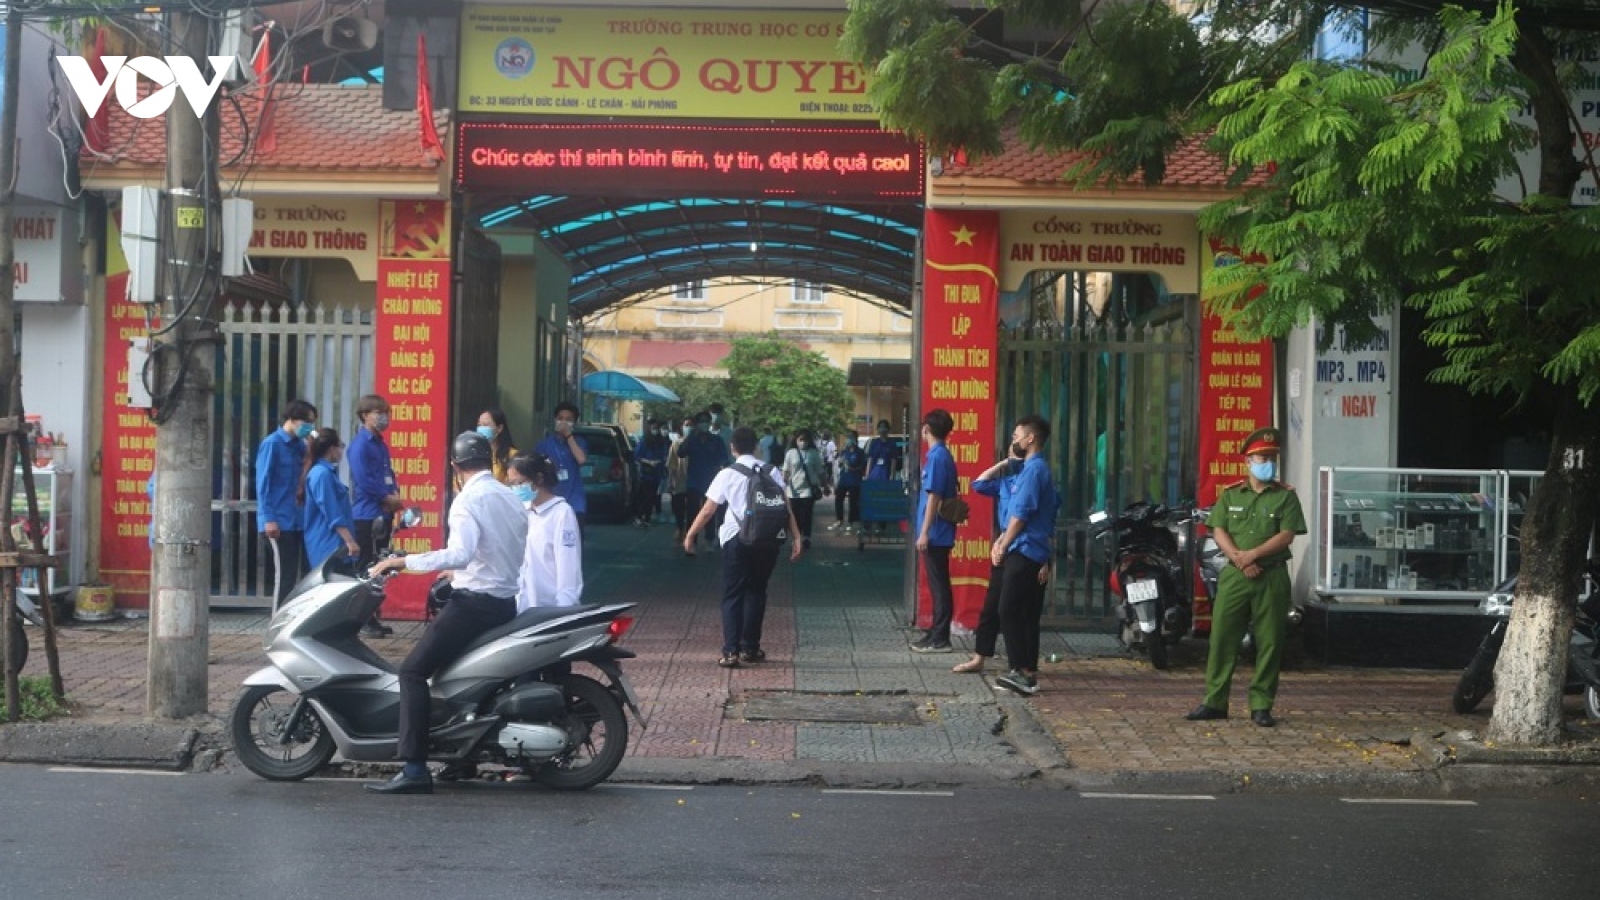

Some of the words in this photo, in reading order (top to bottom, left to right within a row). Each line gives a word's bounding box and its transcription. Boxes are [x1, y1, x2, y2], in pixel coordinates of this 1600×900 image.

[607, 18, 683, 35] TRƯỜNG
[690, 21, 752, 37] TRUNG
[759, 23, 798, 40] HỌC
[804, 22, 830, 38] CƠ
[551, 47, 681, 92] NGÔ
[471, 148, 520, 167] Chúc
[522, 150, 555, 167] các
[586, 149, 623, 167] sinh
[273, 204, 346, 222] TRƯỜNG
[1090, 219, 1162, 236] TRƯỜNG
[270, 231, 307, 249] GIAO
[313, 227, 367, 251] THÔNG
[1010, 243, 1034, 262] AN
[1039, 240, 1083, 262] TOÀN
[1087, 244, 1126, 264] GIAO
[1130, 243, 1186, 265] THÔNG
[383, 295, 409, 315] CHÀO
[944, 284, 959, 304] THI
[952, 312, 971, 340] LẬP
[934, 344, 966, 367] THÀNH
[968, 344, 990, 367] TÍCH
[1316, 361, 1345, 382] MP3
[1357, 361, 1386, 382] MP4
[388, 375, 409, 394] CÁC
[932, 376, 958, 399] CHÀO
[1341, 395, 1377, 417] NGAY
[1563, 447, 1584, 470] 31
